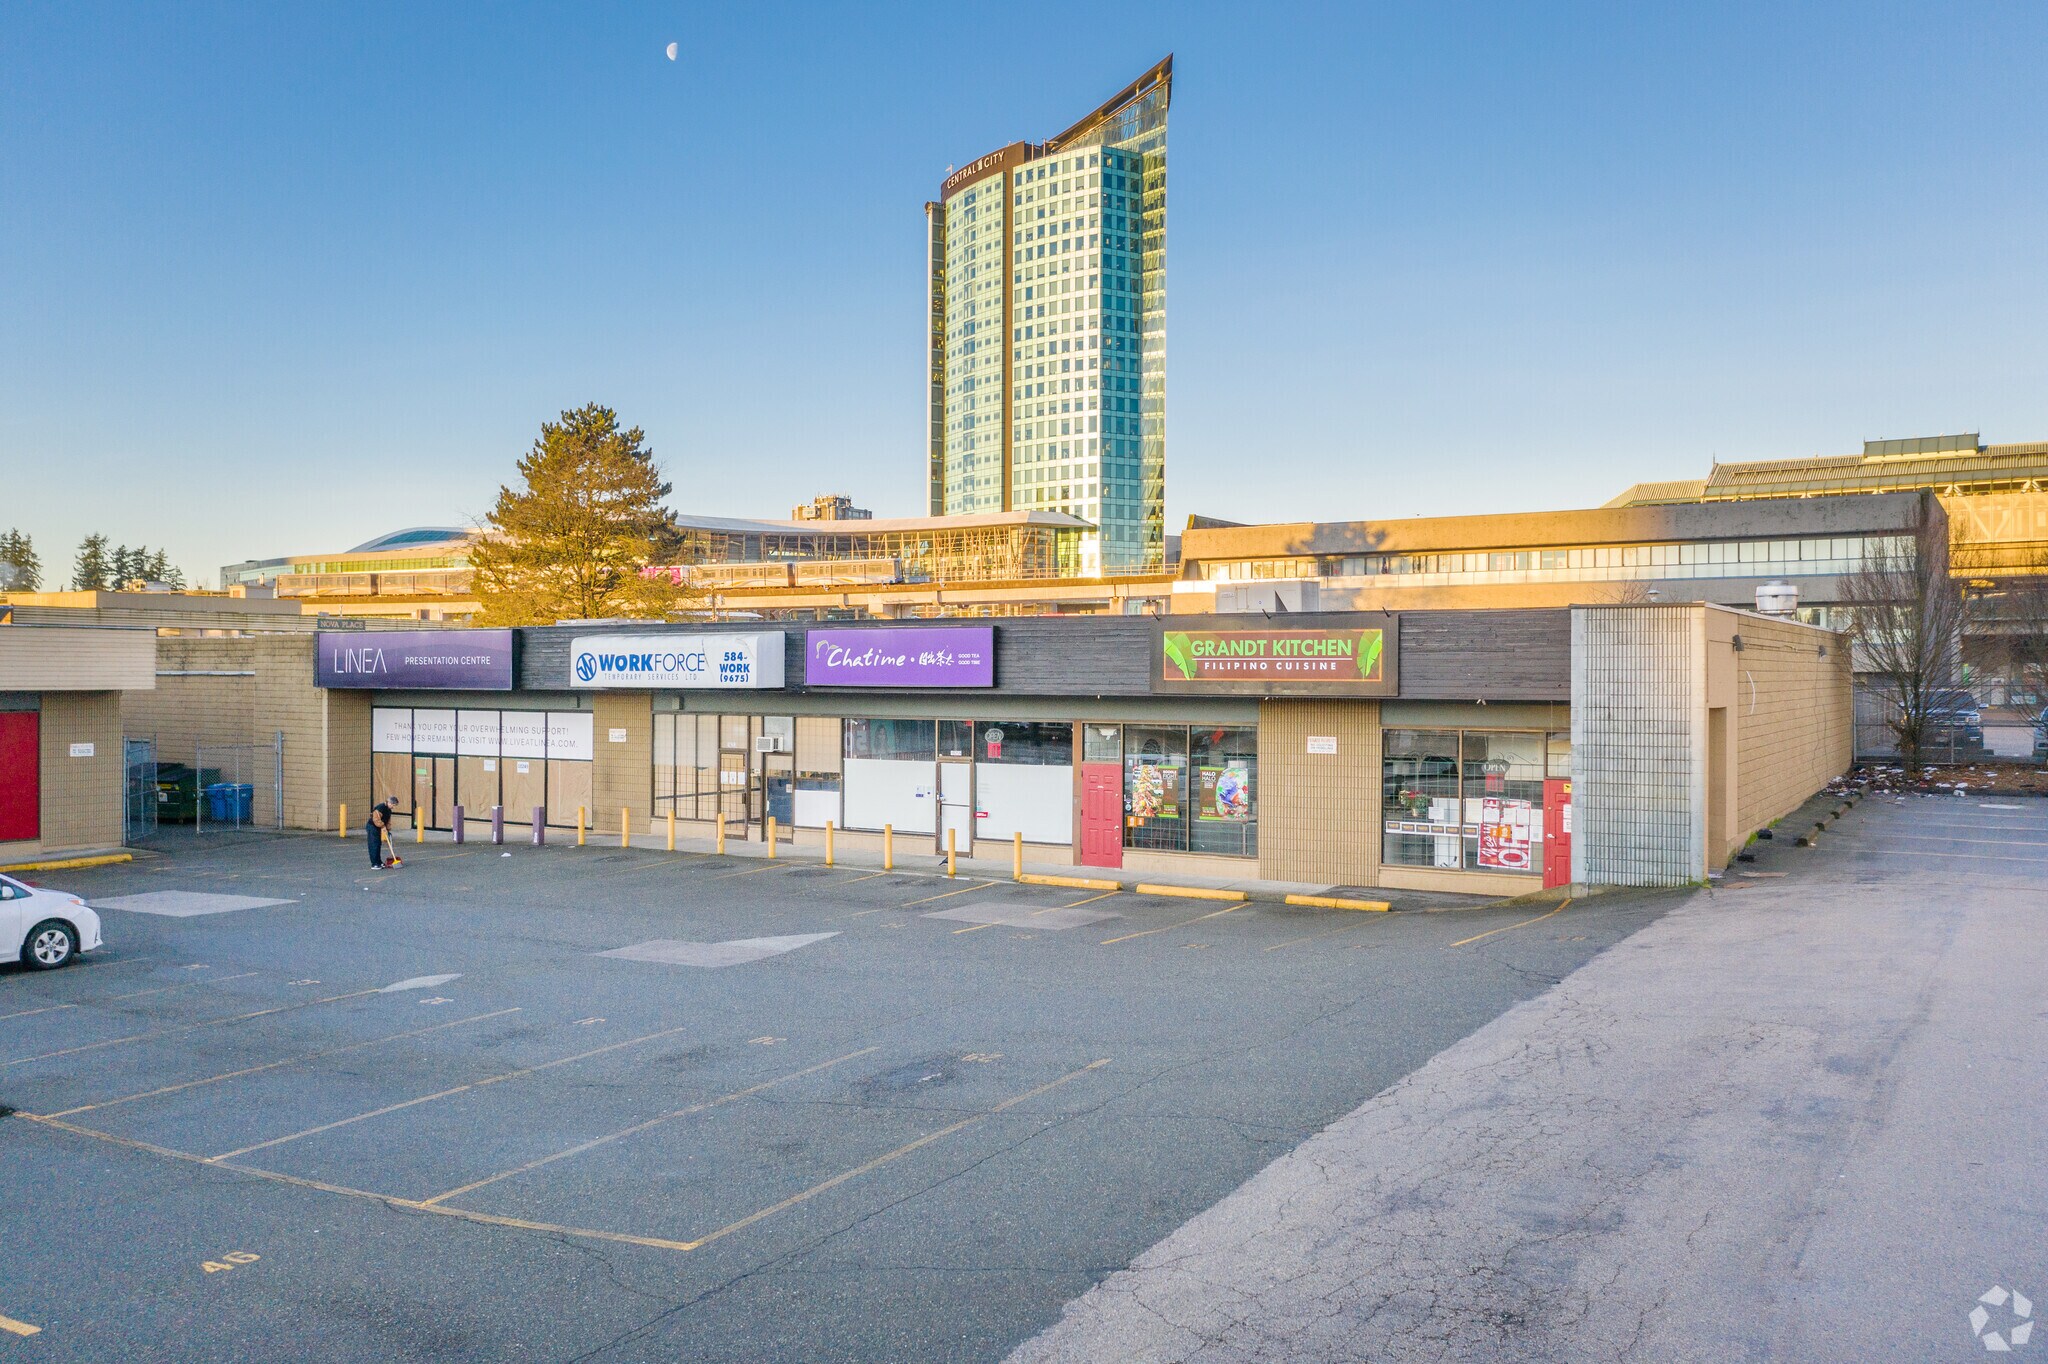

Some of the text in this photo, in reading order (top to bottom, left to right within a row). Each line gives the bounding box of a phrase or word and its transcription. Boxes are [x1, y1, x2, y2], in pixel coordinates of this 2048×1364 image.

[946, 151, 1005, 189] CENTRAL CITY
[320, 620, 364, 629] NOVA PLACE
[1190, 639, 1352, 656] GRANDT KITCHEN
[334, 648, 388, 673] LINEA
[405, 656, 491, 665] PRESENTATION CENTRE
[724, 651, 748, 662] 584-
[827, 648, 905, 667] Chatime
[598, 652, 705, 672] WORKFORCE
[1204, 662, 1337, 670] FILIPINO CUISINE
[719, 663, 750, 673] WORK
[647, 673, 679, 681] SERVICES
[720, 673, 749, 683] (9675)
[418, 723, 432, 731] YOU
[386, 733, 400, 741] FEW
[1484, 763, 1506, 772] OPEN
